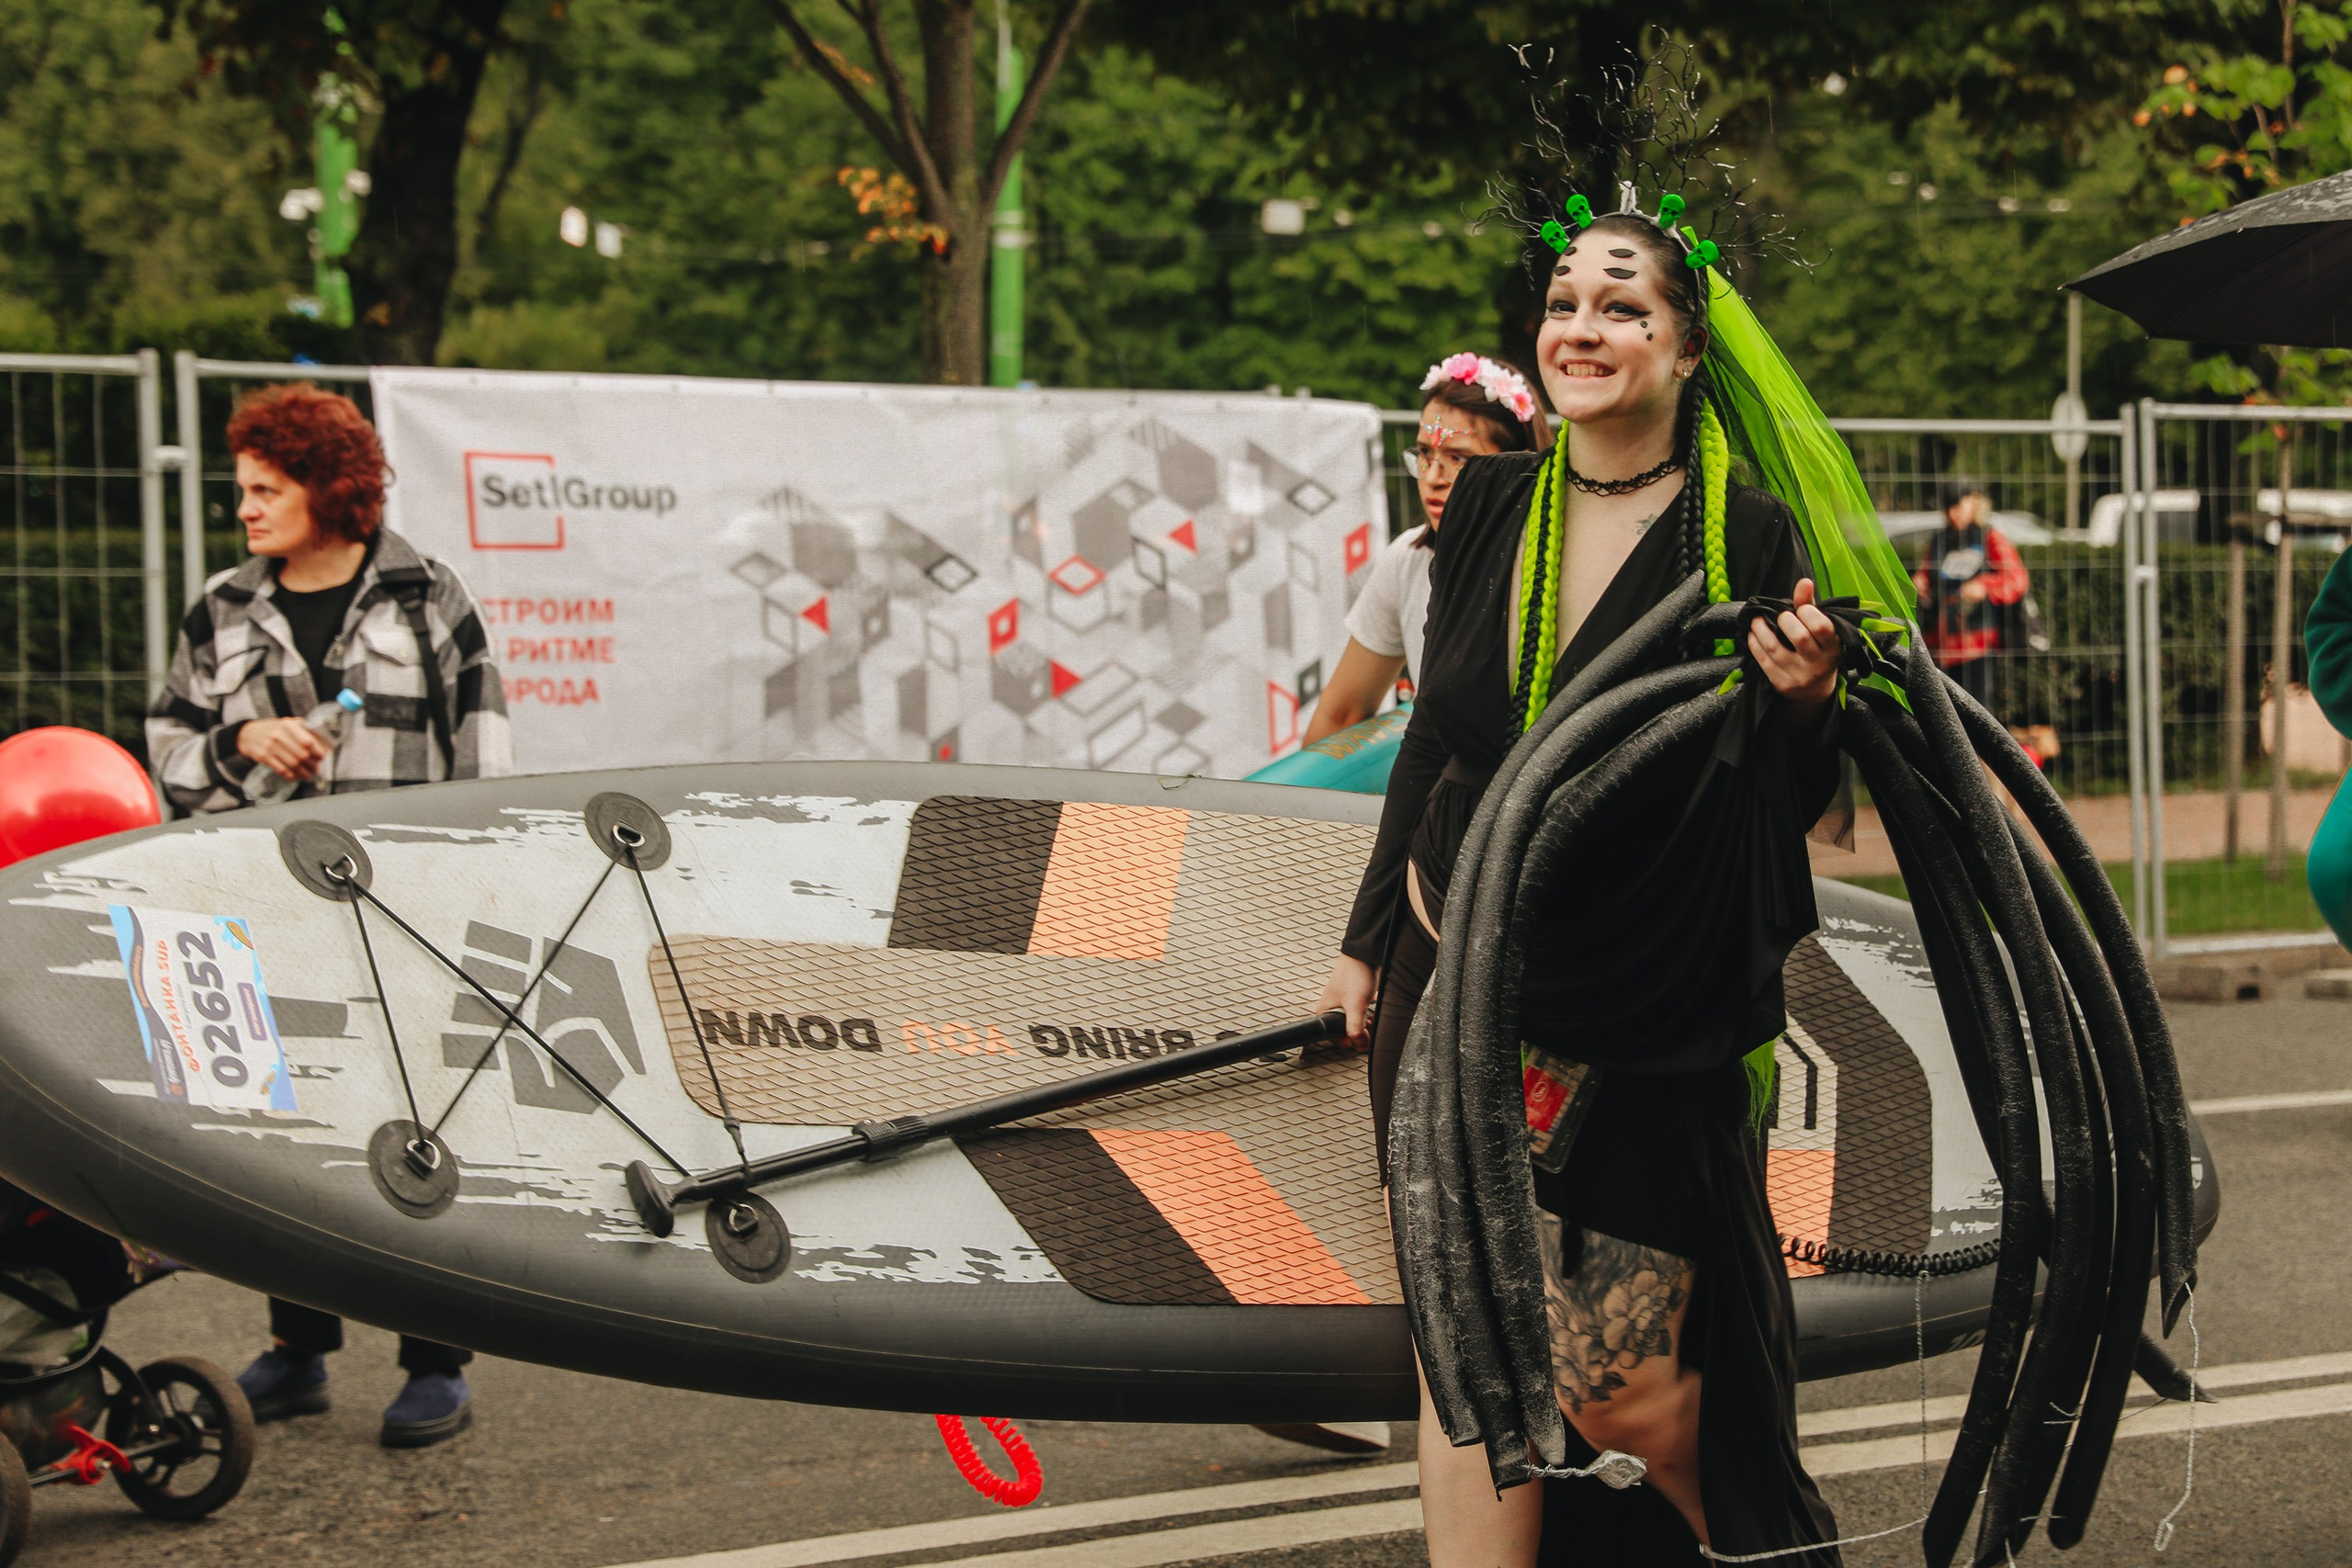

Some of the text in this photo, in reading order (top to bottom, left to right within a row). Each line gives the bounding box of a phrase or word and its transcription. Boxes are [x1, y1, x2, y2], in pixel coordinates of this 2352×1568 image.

[508, 637, 616, 663] РИТМЕ
[502, 677, 600, 707] РОДА
[156, 940, 170, 971] SUP
[160, 976, 201, 1073] ФОНТАНКА
[176, 931, 249, 1088] 02652
[699, 1010, 884, 1053] DOWN
[900, 1020, 1020, 1057] YOU
[1028, 1024, 1195, 1061] BRING
